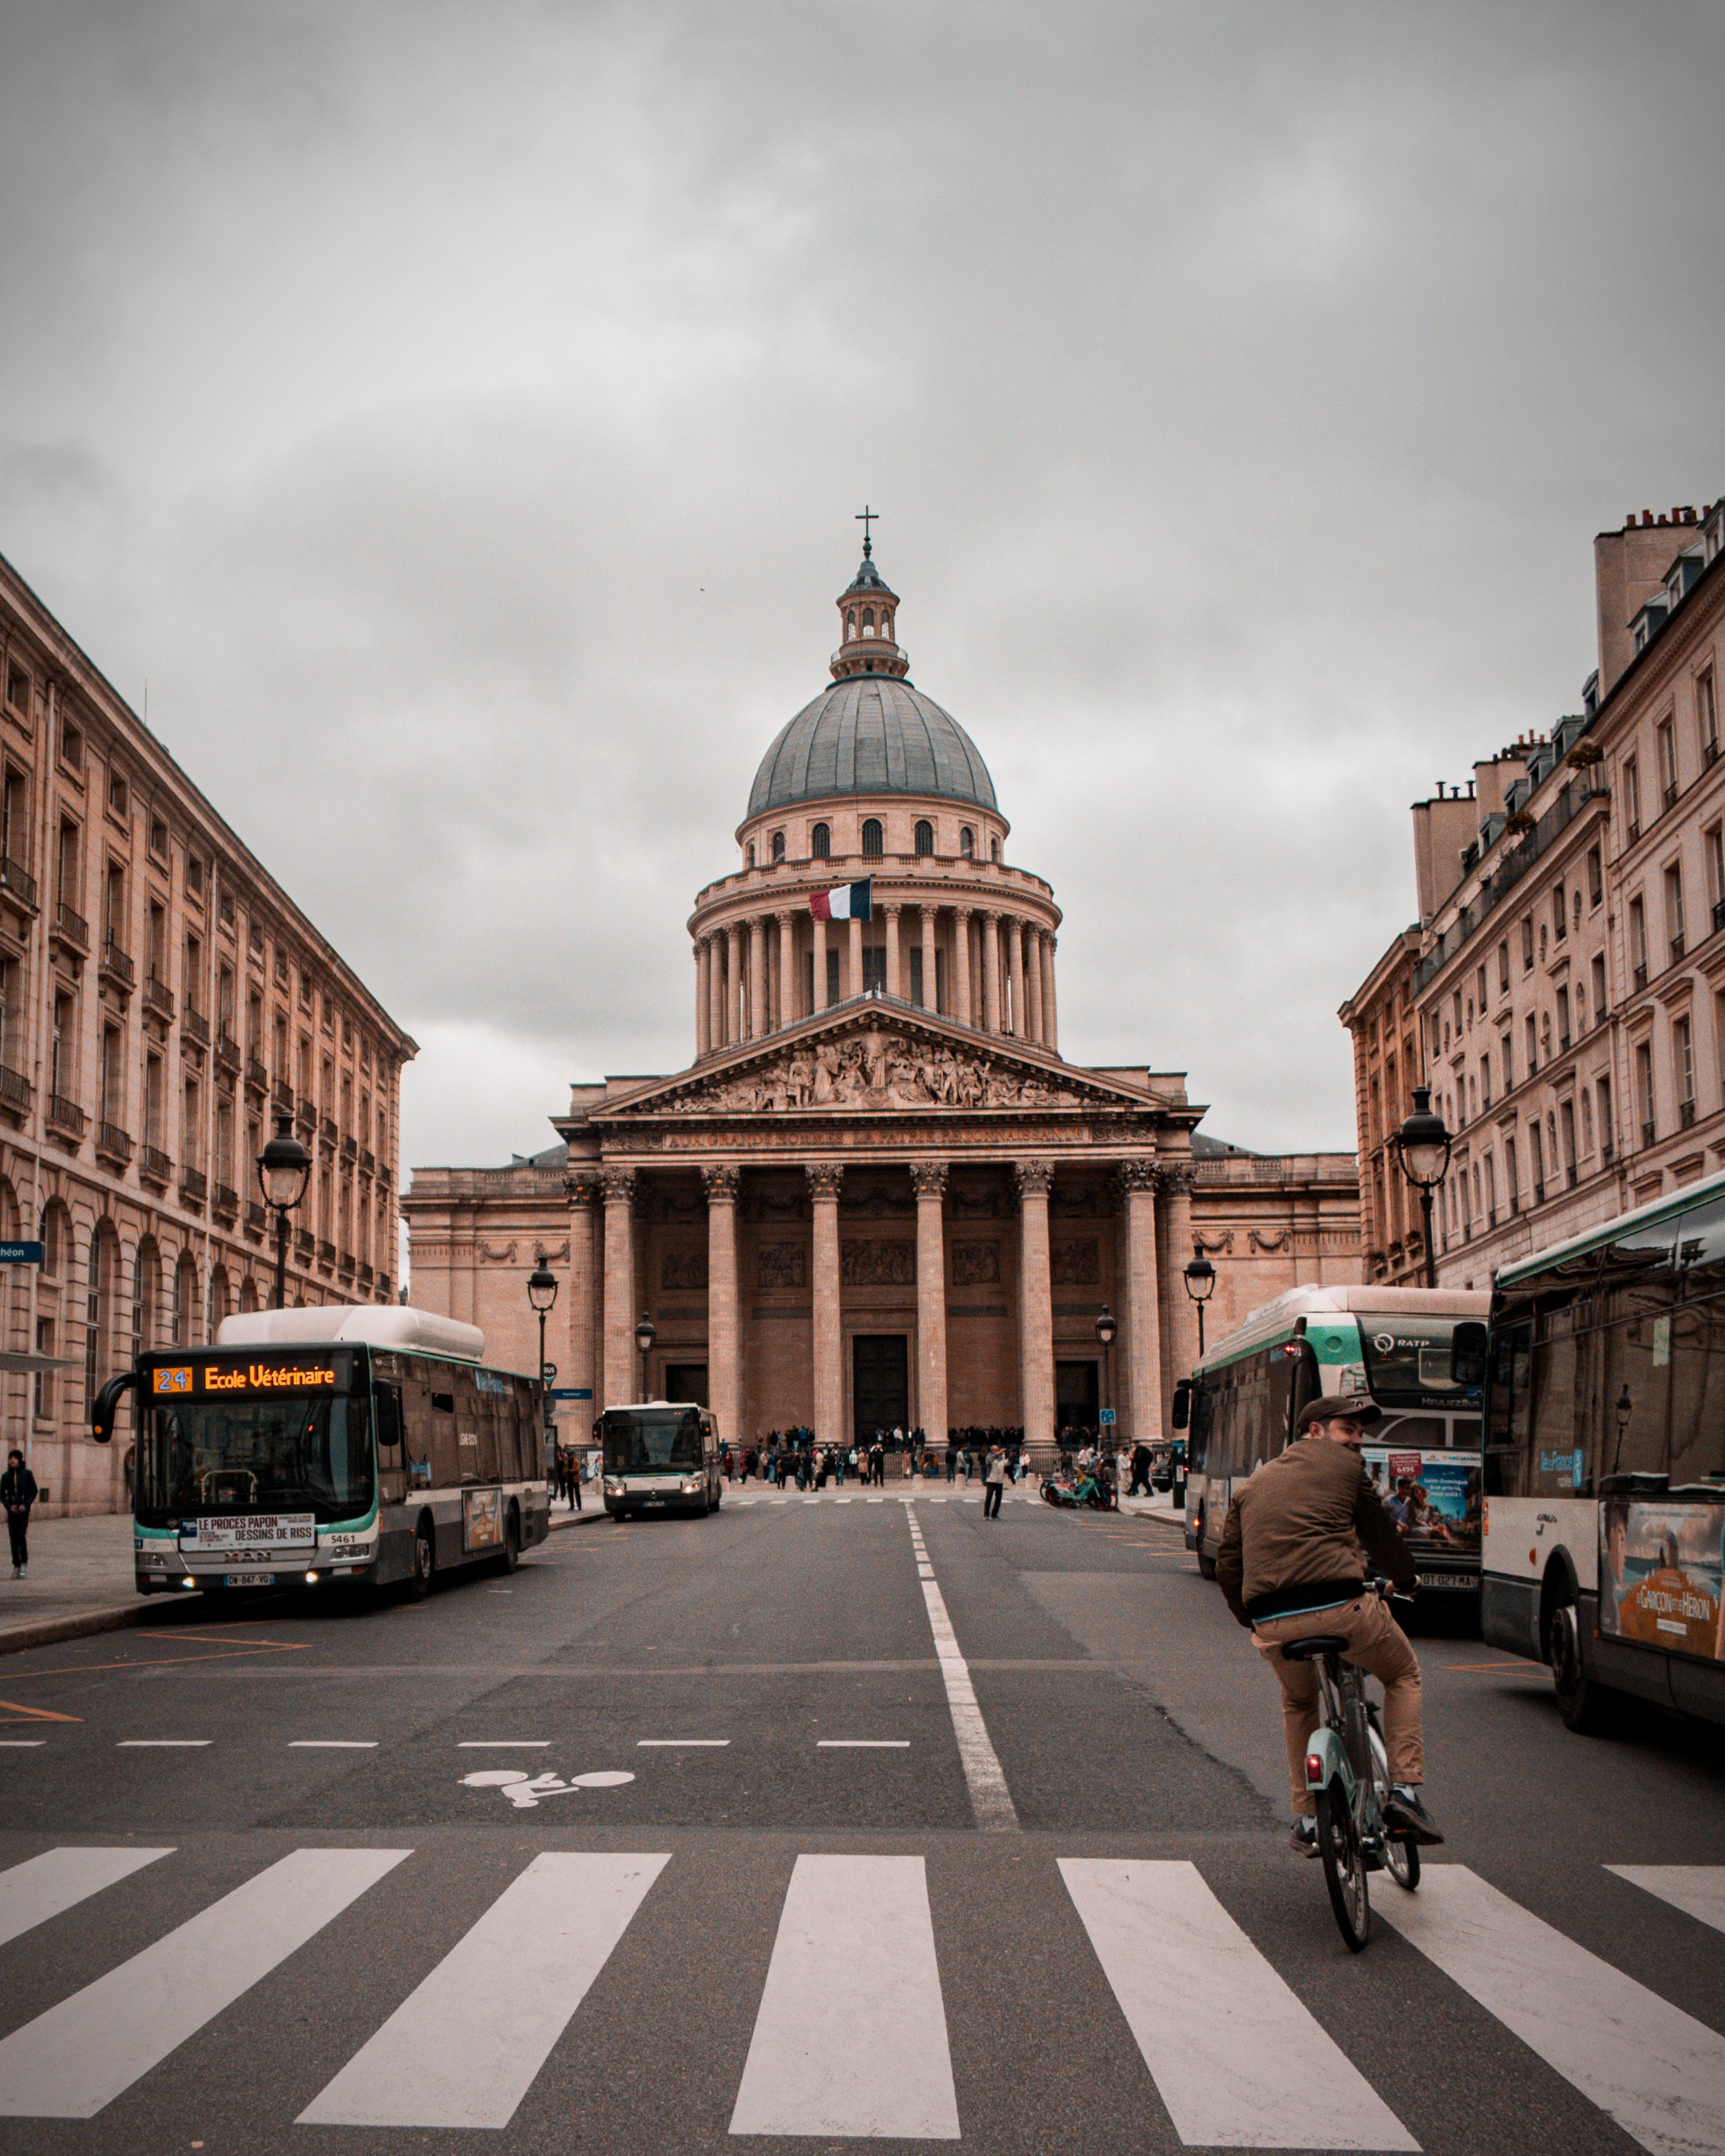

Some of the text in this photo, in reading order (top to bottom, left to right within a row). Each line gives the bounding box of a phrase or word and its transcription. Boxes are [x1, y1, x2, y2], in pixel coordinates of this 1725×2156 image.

[669, 1134, 702, 1147] AUX
[707, 1133, 772, 1145] GRANDS
[775, 1131, 845, 1144] HOMMES
[941, 1127, 1083, 1142] RECONNAISSANTE
[0, 1247, 24, 1256] héon
[159, 1365, 334, 1391] 24 Ecole Vétérinaire
[199, 1519, 210, 1530] LE
[248, 1516, 278, 1528] PAPON
[235, 1528, 274, 1541] DESSINS
[277, 1527, 288, 1539] DE
[290, 1526, 312, 1539] RISS
[331, 1535, 355, 1543] 5461
